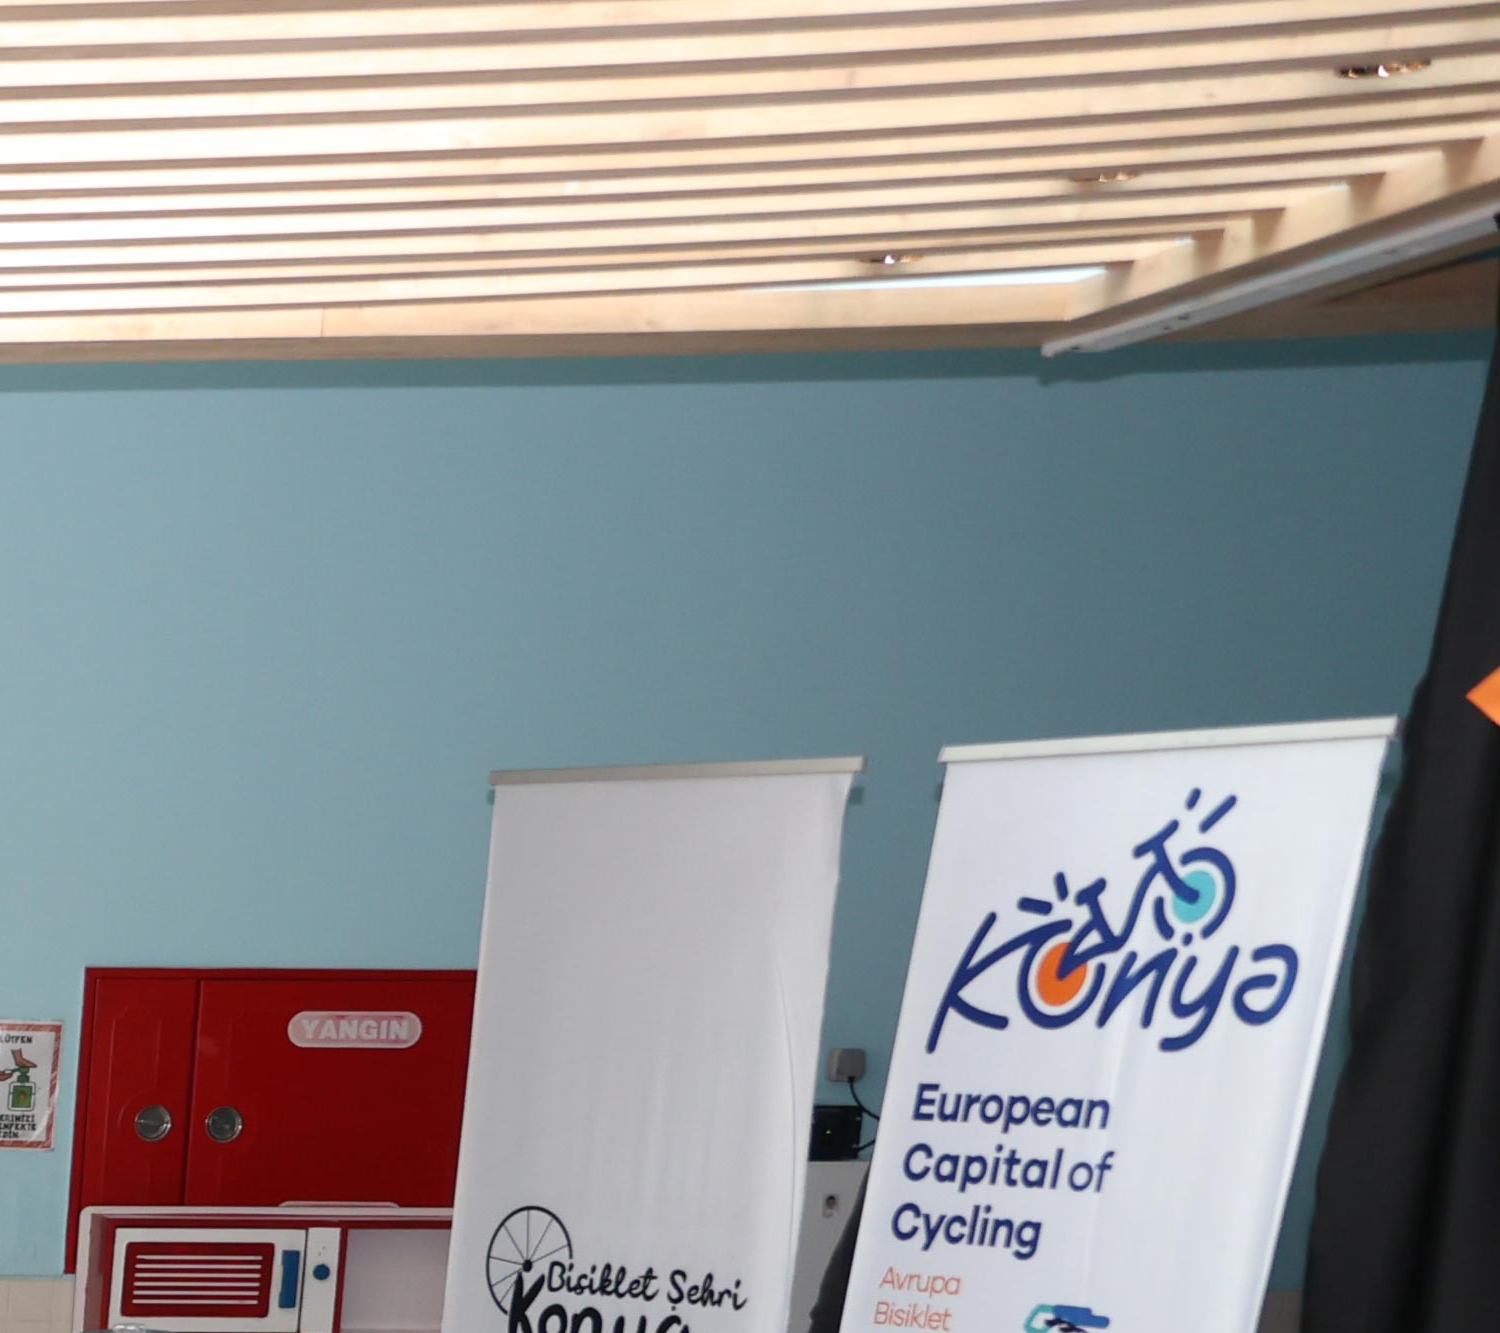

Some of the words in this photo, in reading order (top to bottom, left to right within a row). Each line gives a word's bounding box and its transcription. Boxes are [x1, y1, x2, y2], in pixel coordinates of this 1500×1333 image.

[925, 911, 1300, 1054] Konya
[0, 1034, 33, 1044] LÜTFEN
[301, 1018, 409, 1041] YANGIN
[911, 1082, 1112, 1132] European
[902, 1143, 1062, 1194] Capital
[1068, 1150, 1115, 1193] of
[891, 1202, 1043, 1260] Cycling
[546, 1260, 660, 1302] Bisiklet
[666, 1270, 748, 1317] Şehri
[878, 1266, 962, 1299] Avrupa
[873, 1301, 952, 1333] Bisiklet
